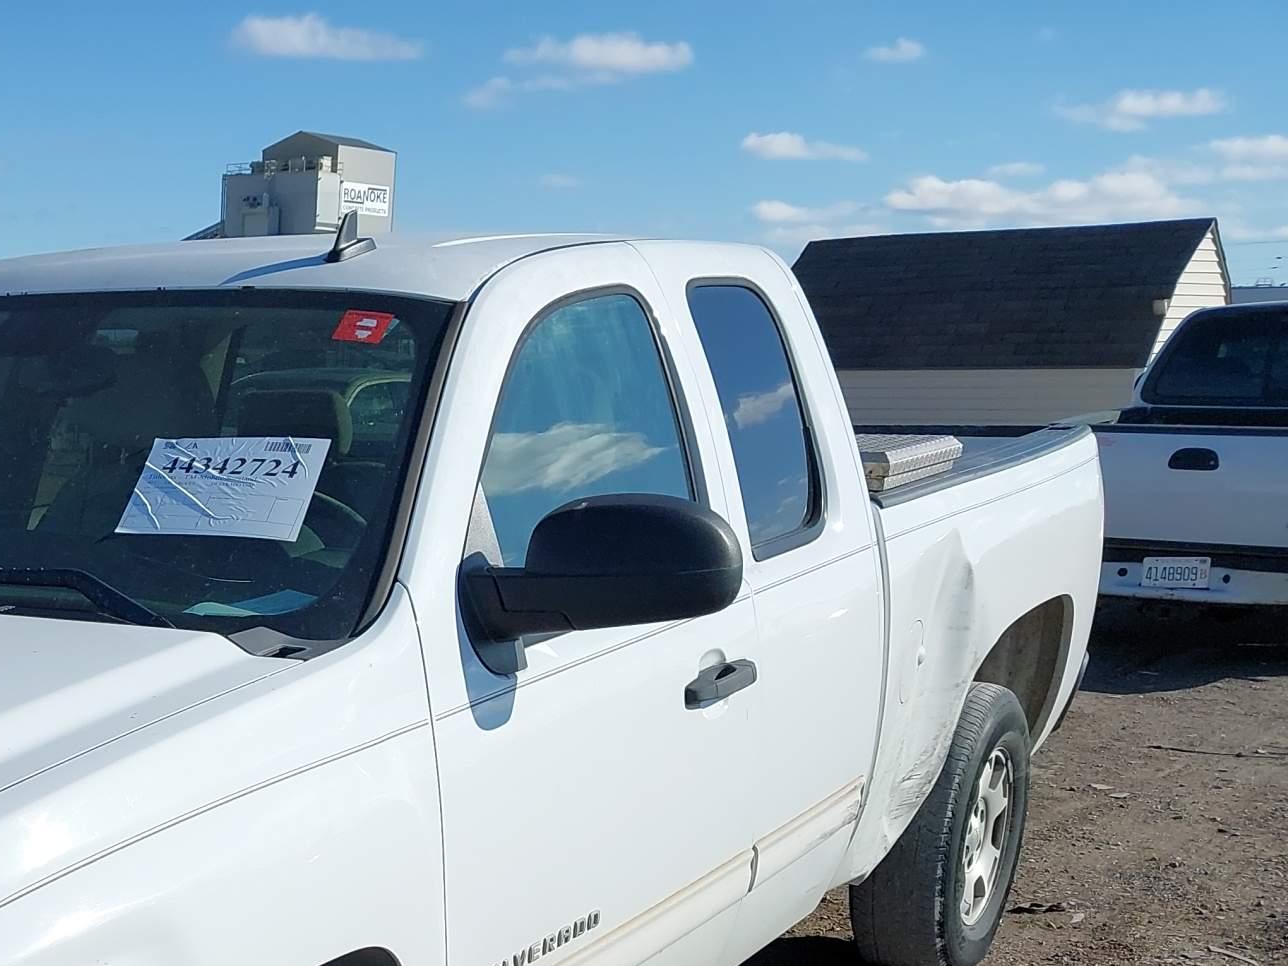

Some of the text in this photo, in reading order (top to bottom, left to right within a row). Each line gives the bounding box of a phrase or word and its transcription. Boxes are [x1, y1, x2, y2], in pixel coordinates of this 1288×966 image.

[343, 187, 387, 203] ROANOKE
[162, 456, 302, 479] 44342724
[1145, 566, 1199, 582] 4148909
